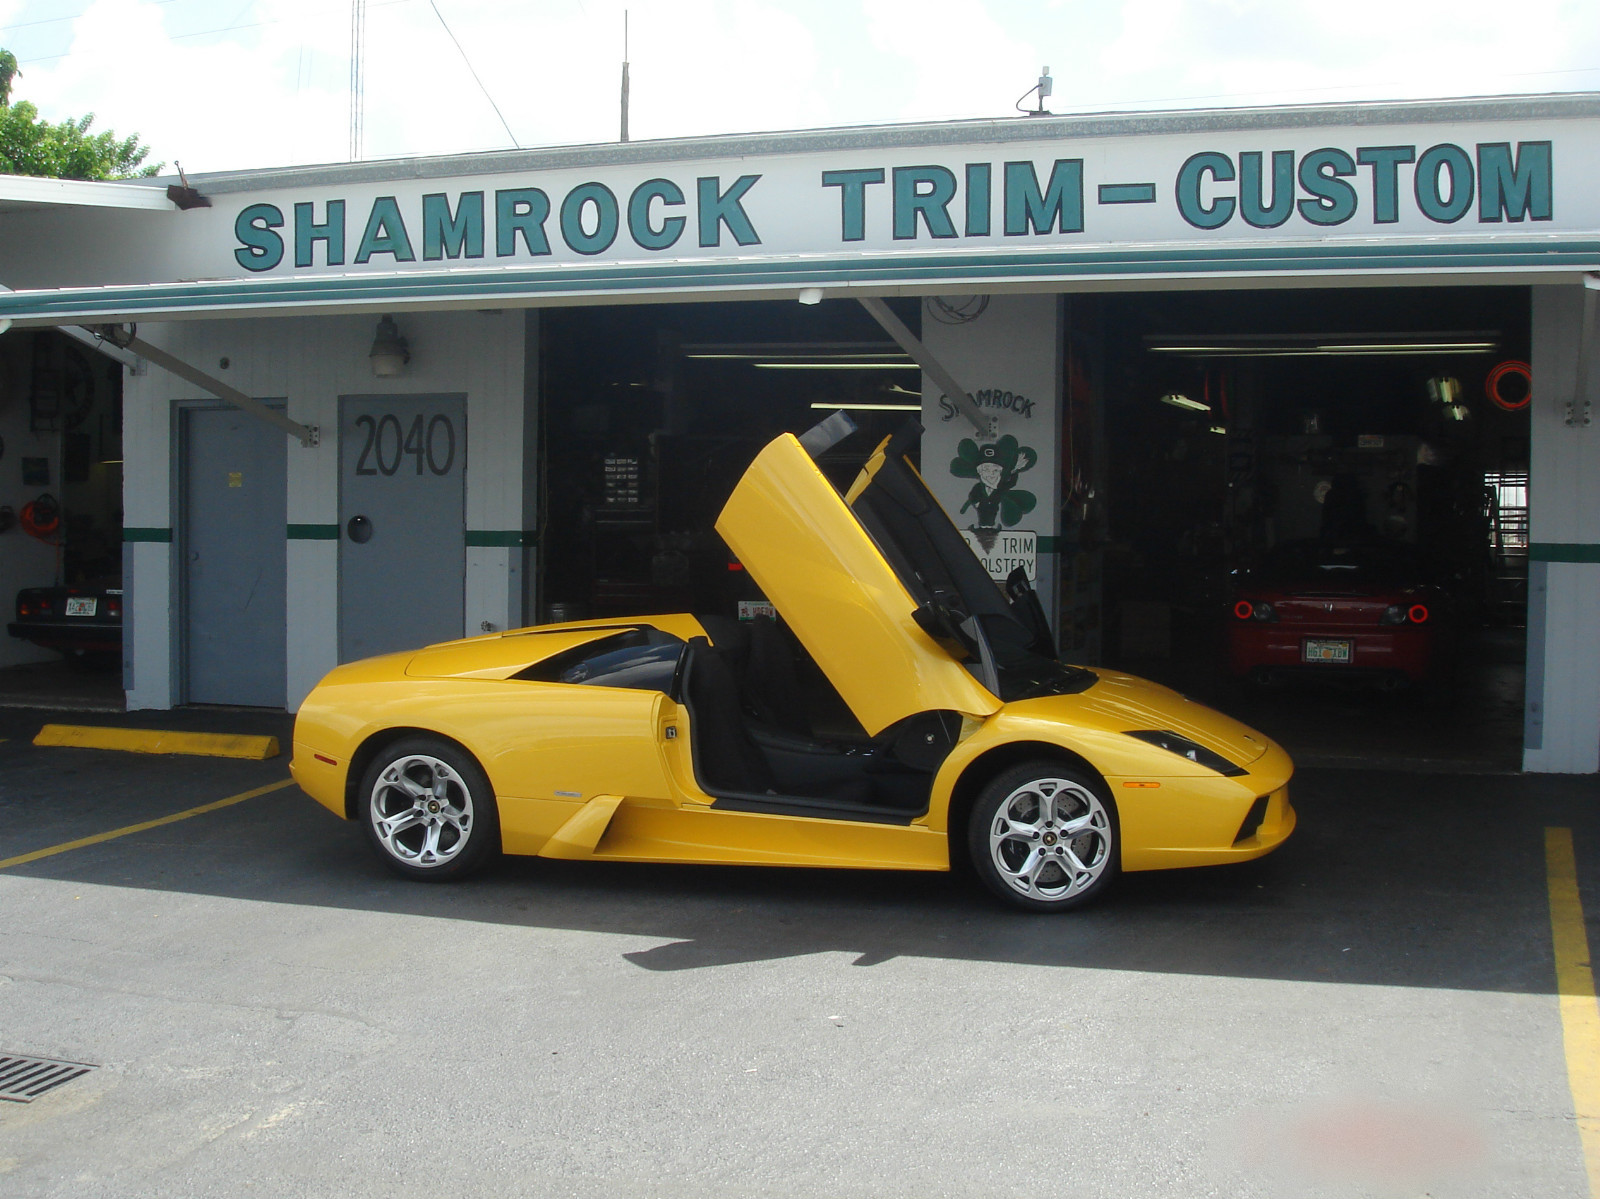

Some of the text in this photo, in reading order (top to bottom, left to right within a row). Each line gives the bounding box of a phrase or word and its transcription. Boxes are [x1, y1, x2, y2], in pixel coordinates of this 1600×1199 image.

[234, 174, 762, 272] SHAMROCK
[939, 389, 1036, 420] SMROCK
[355, 413, 455, 476] 2040
[1003, 537, 1033, 554] TRIM
